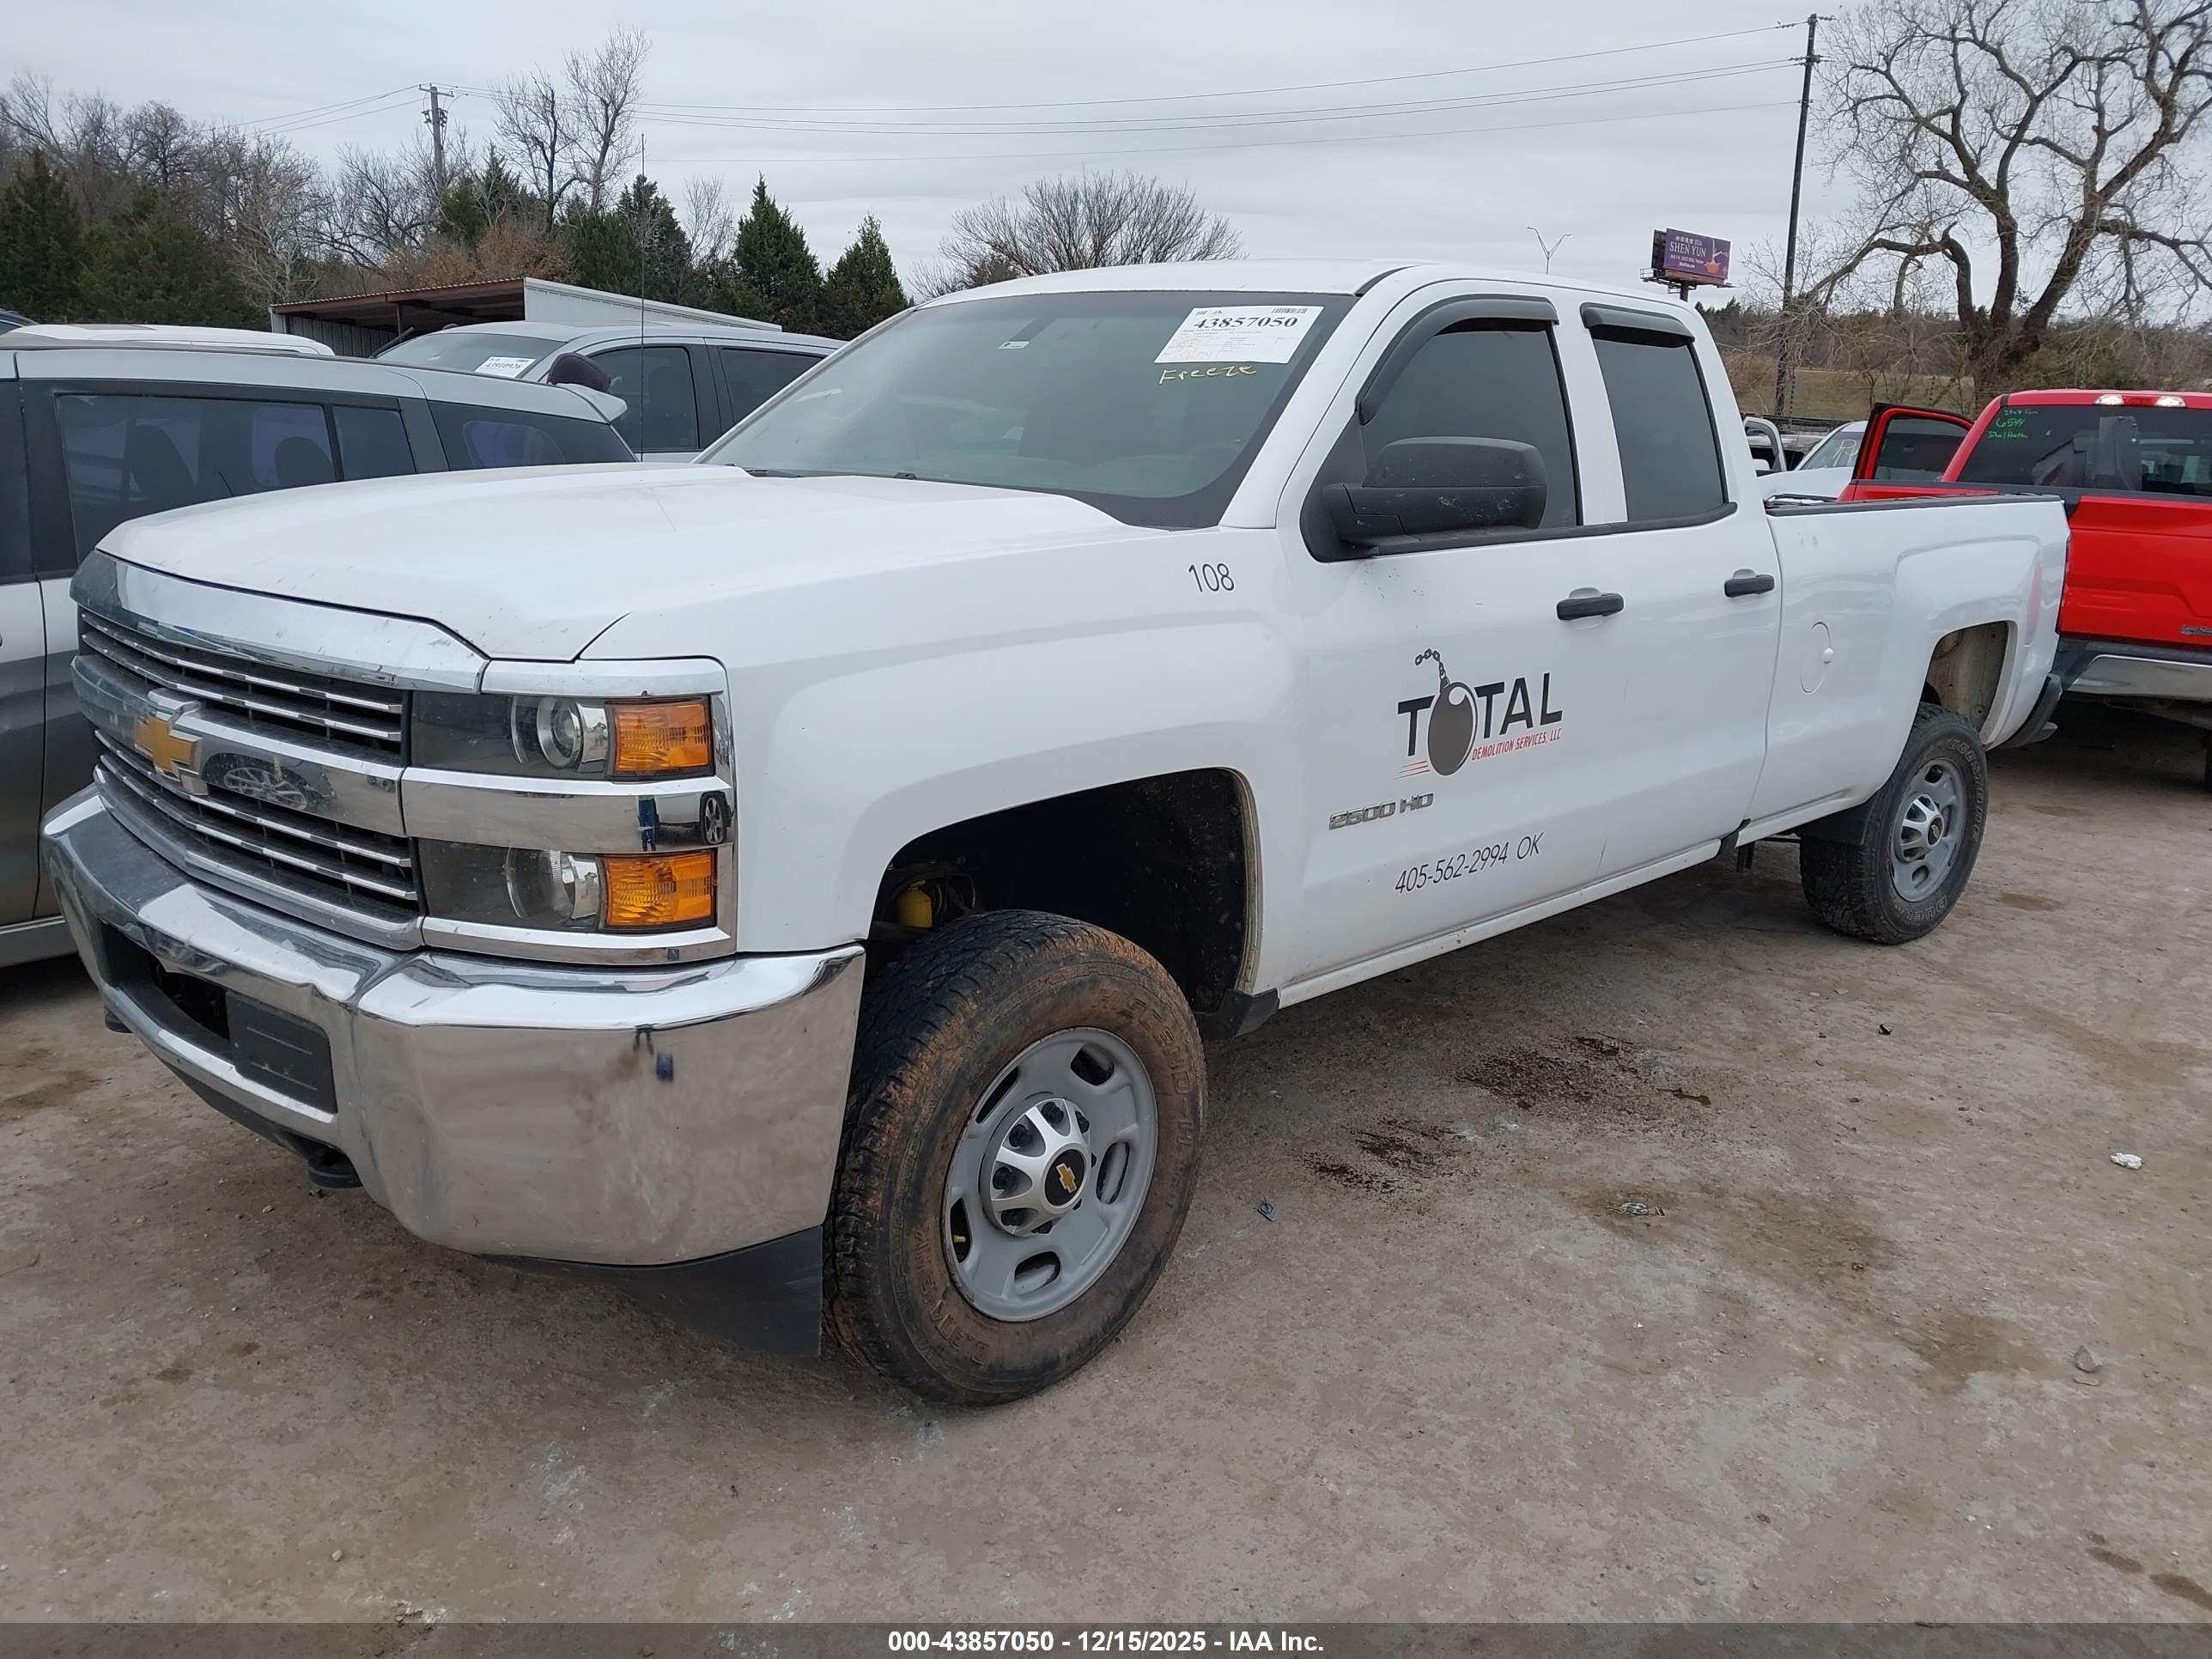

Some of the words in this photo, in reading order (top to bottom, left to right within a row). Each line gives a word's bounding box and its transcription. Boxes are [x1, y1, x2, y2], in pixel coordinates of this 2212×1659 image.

[1669, 241, 1690, 254] SHEN
[1692, 246, 1705, 257] YUN
[1194, 316, 1298, 329] 43857050
[1158, 364, 1257, 385] Freeze
[1188, 562, 1235, 592] 108
[1397, 672, 1563, 775] TOTAL
[1471, 739, 1515, 762] DEMOLITION
[1549, 727, 1563, 743] LLC
[1328, 799, 1396, 830] 2500
[1399, 792, 1434, 814] HD
[1395, 842, 1509, 894] 405-562-2994
[1516, 831, 1545, 860] OK
